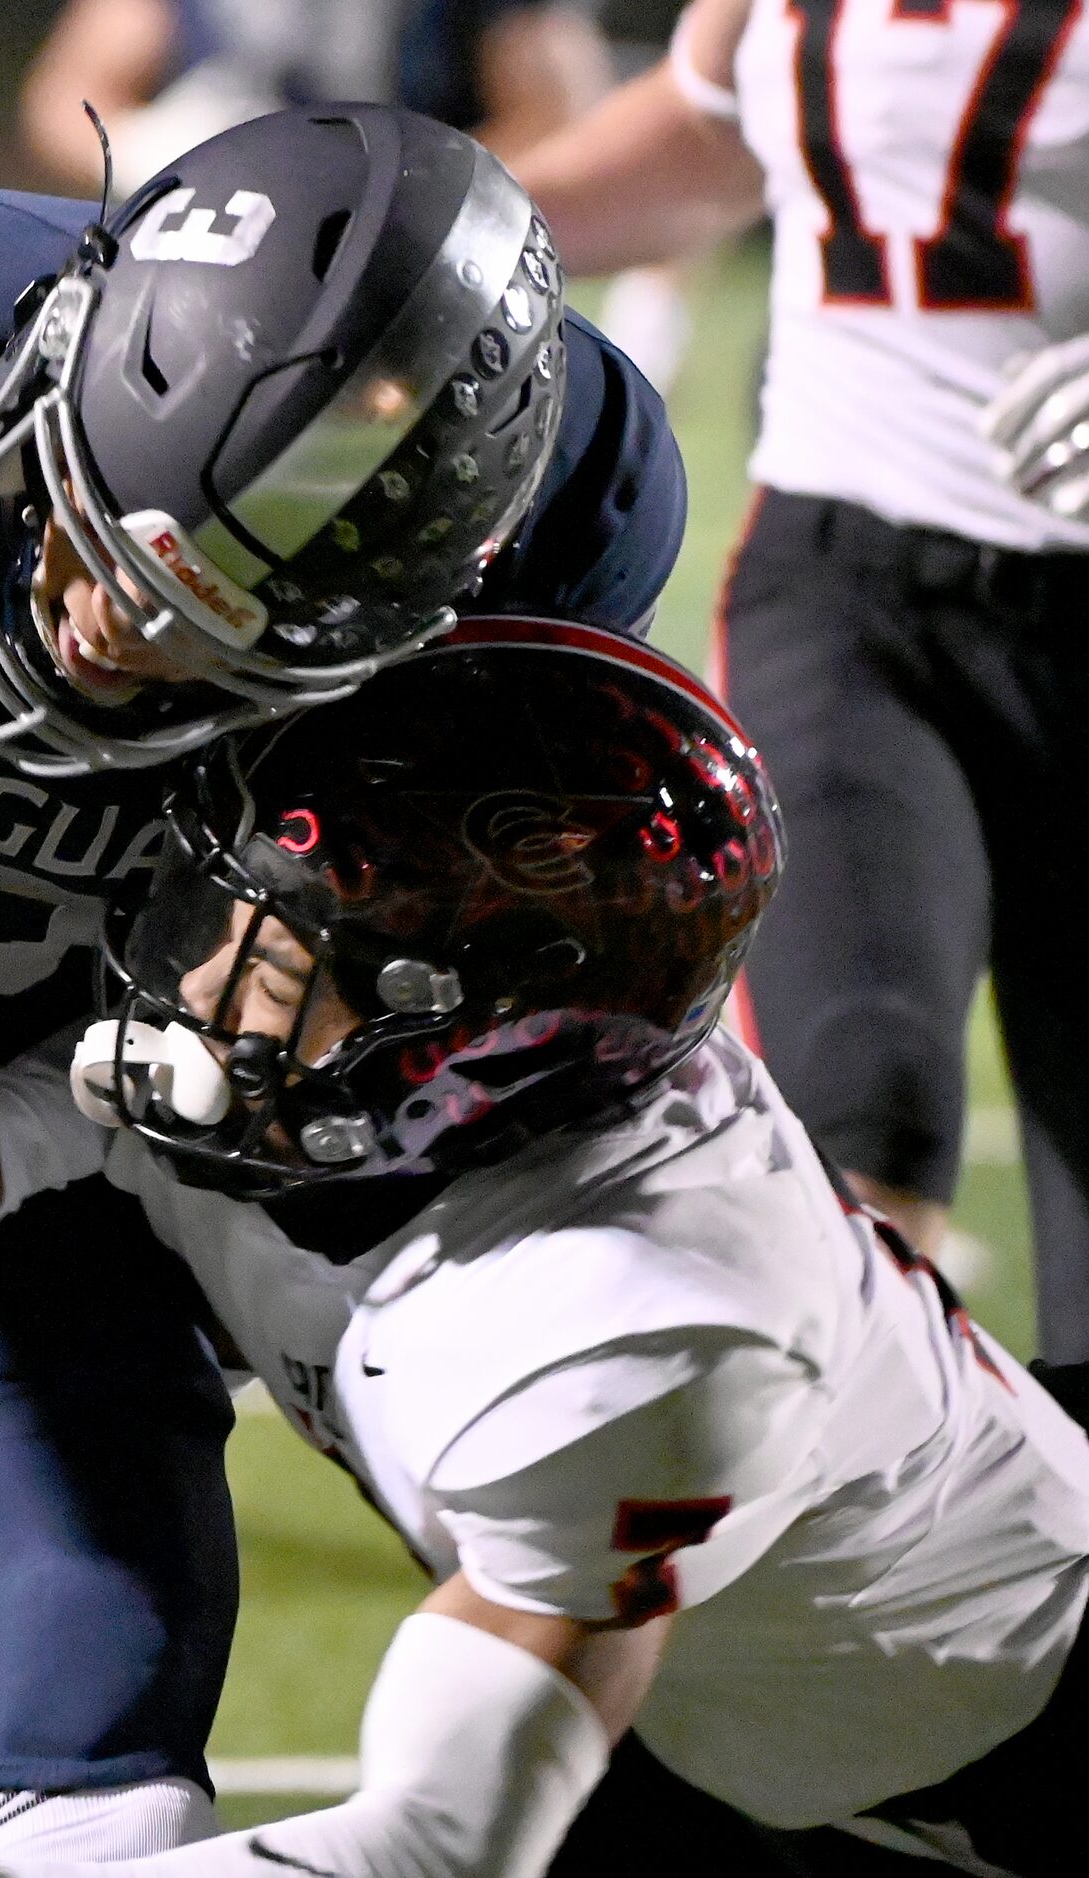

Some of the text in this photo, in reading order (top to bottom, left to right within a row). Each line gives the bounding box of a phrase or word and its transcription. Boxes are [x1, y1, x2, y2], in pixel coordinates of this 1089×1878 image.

[782, 0, 1086, 312] 17
[130, 187, 277, 267] 3
[609, 1494, 734, 1628] 7
